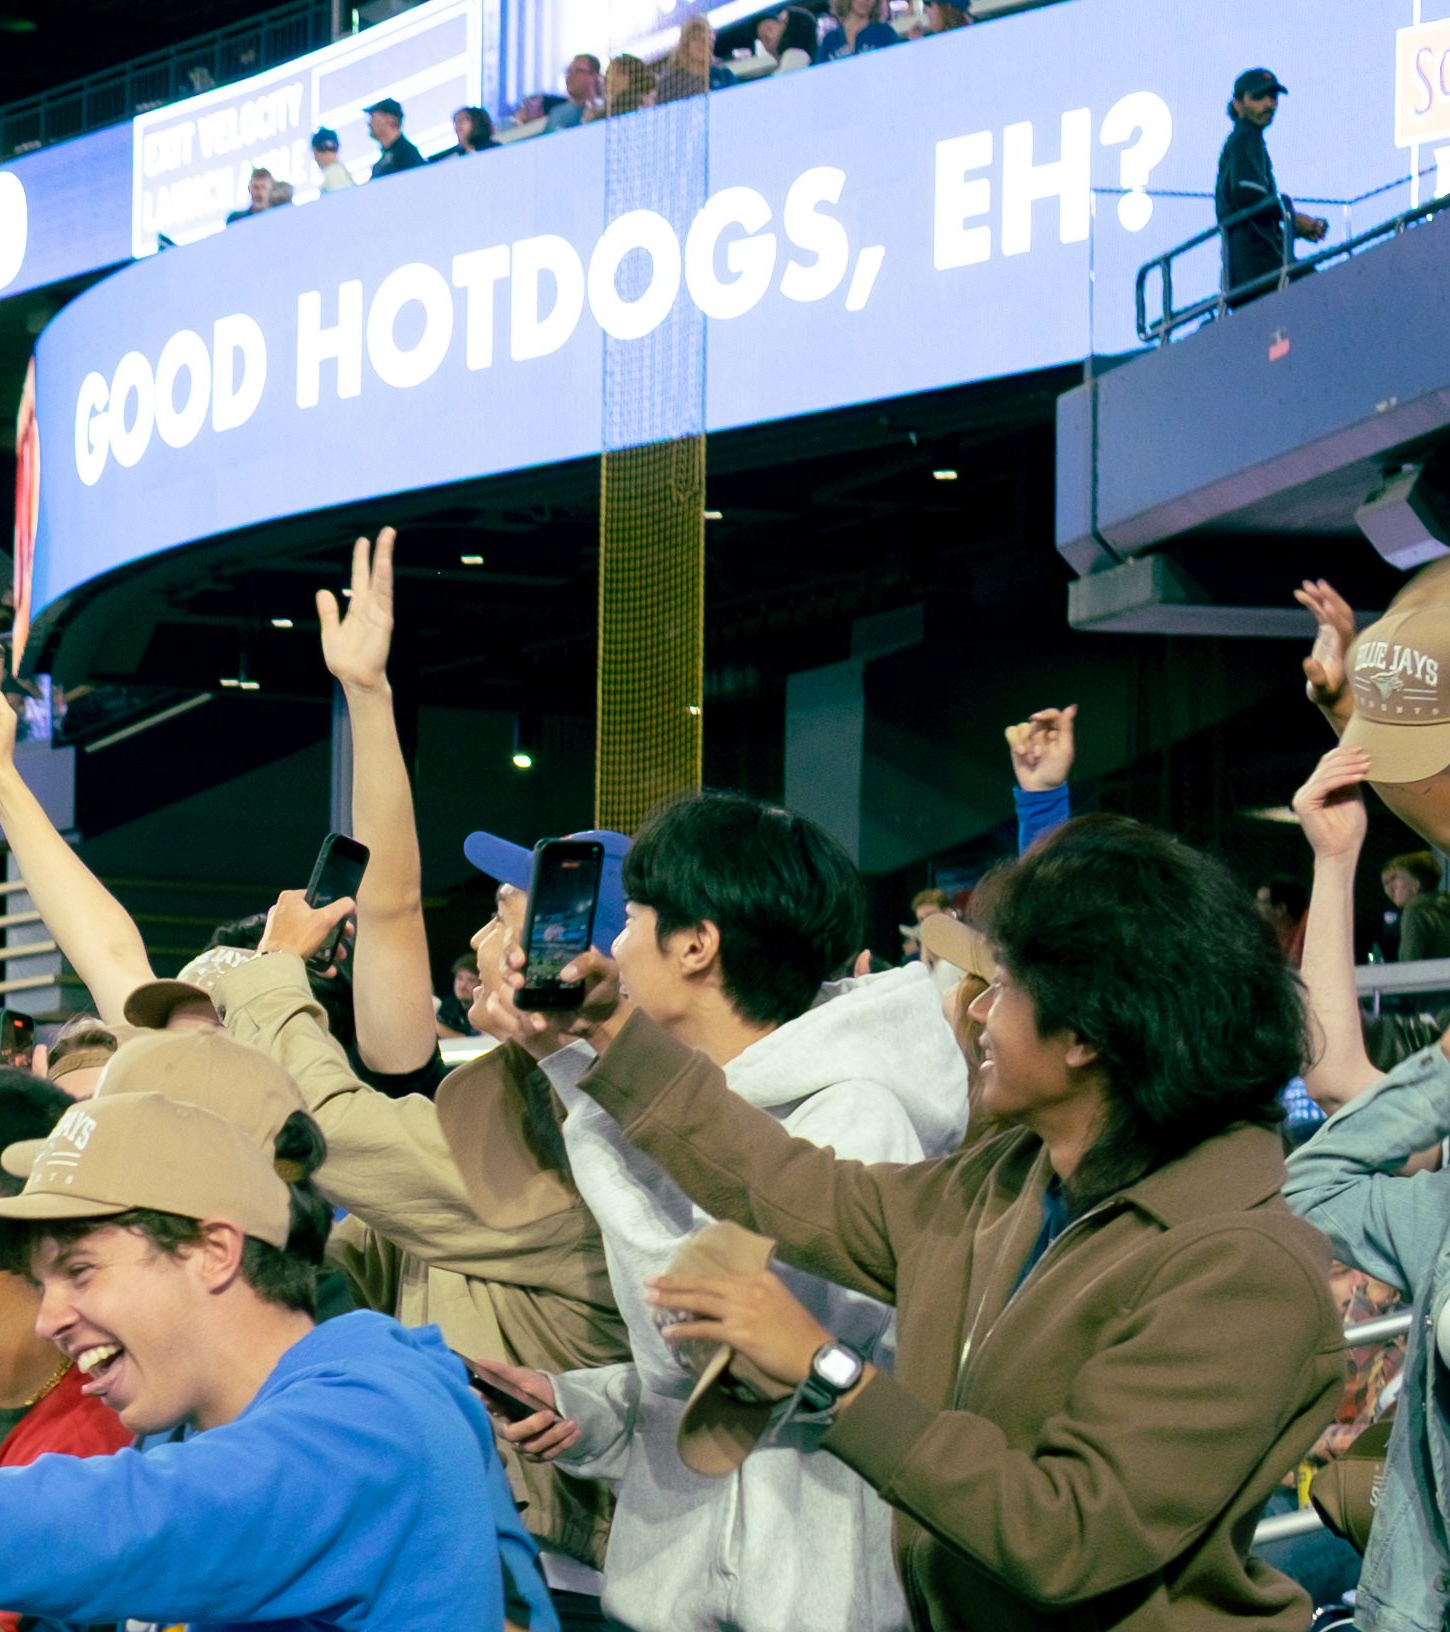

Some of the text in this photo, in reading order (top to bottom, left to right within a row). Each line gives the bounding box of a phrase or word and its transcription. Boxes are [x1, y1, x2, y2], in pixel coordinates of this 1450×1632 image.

[143, 82, 304, 177] EXIT VELOCITY
[74, 90, 1174, 488] GOOD HOTDOGS, EH?
[1389, 645, 1439, 687] JAYS
